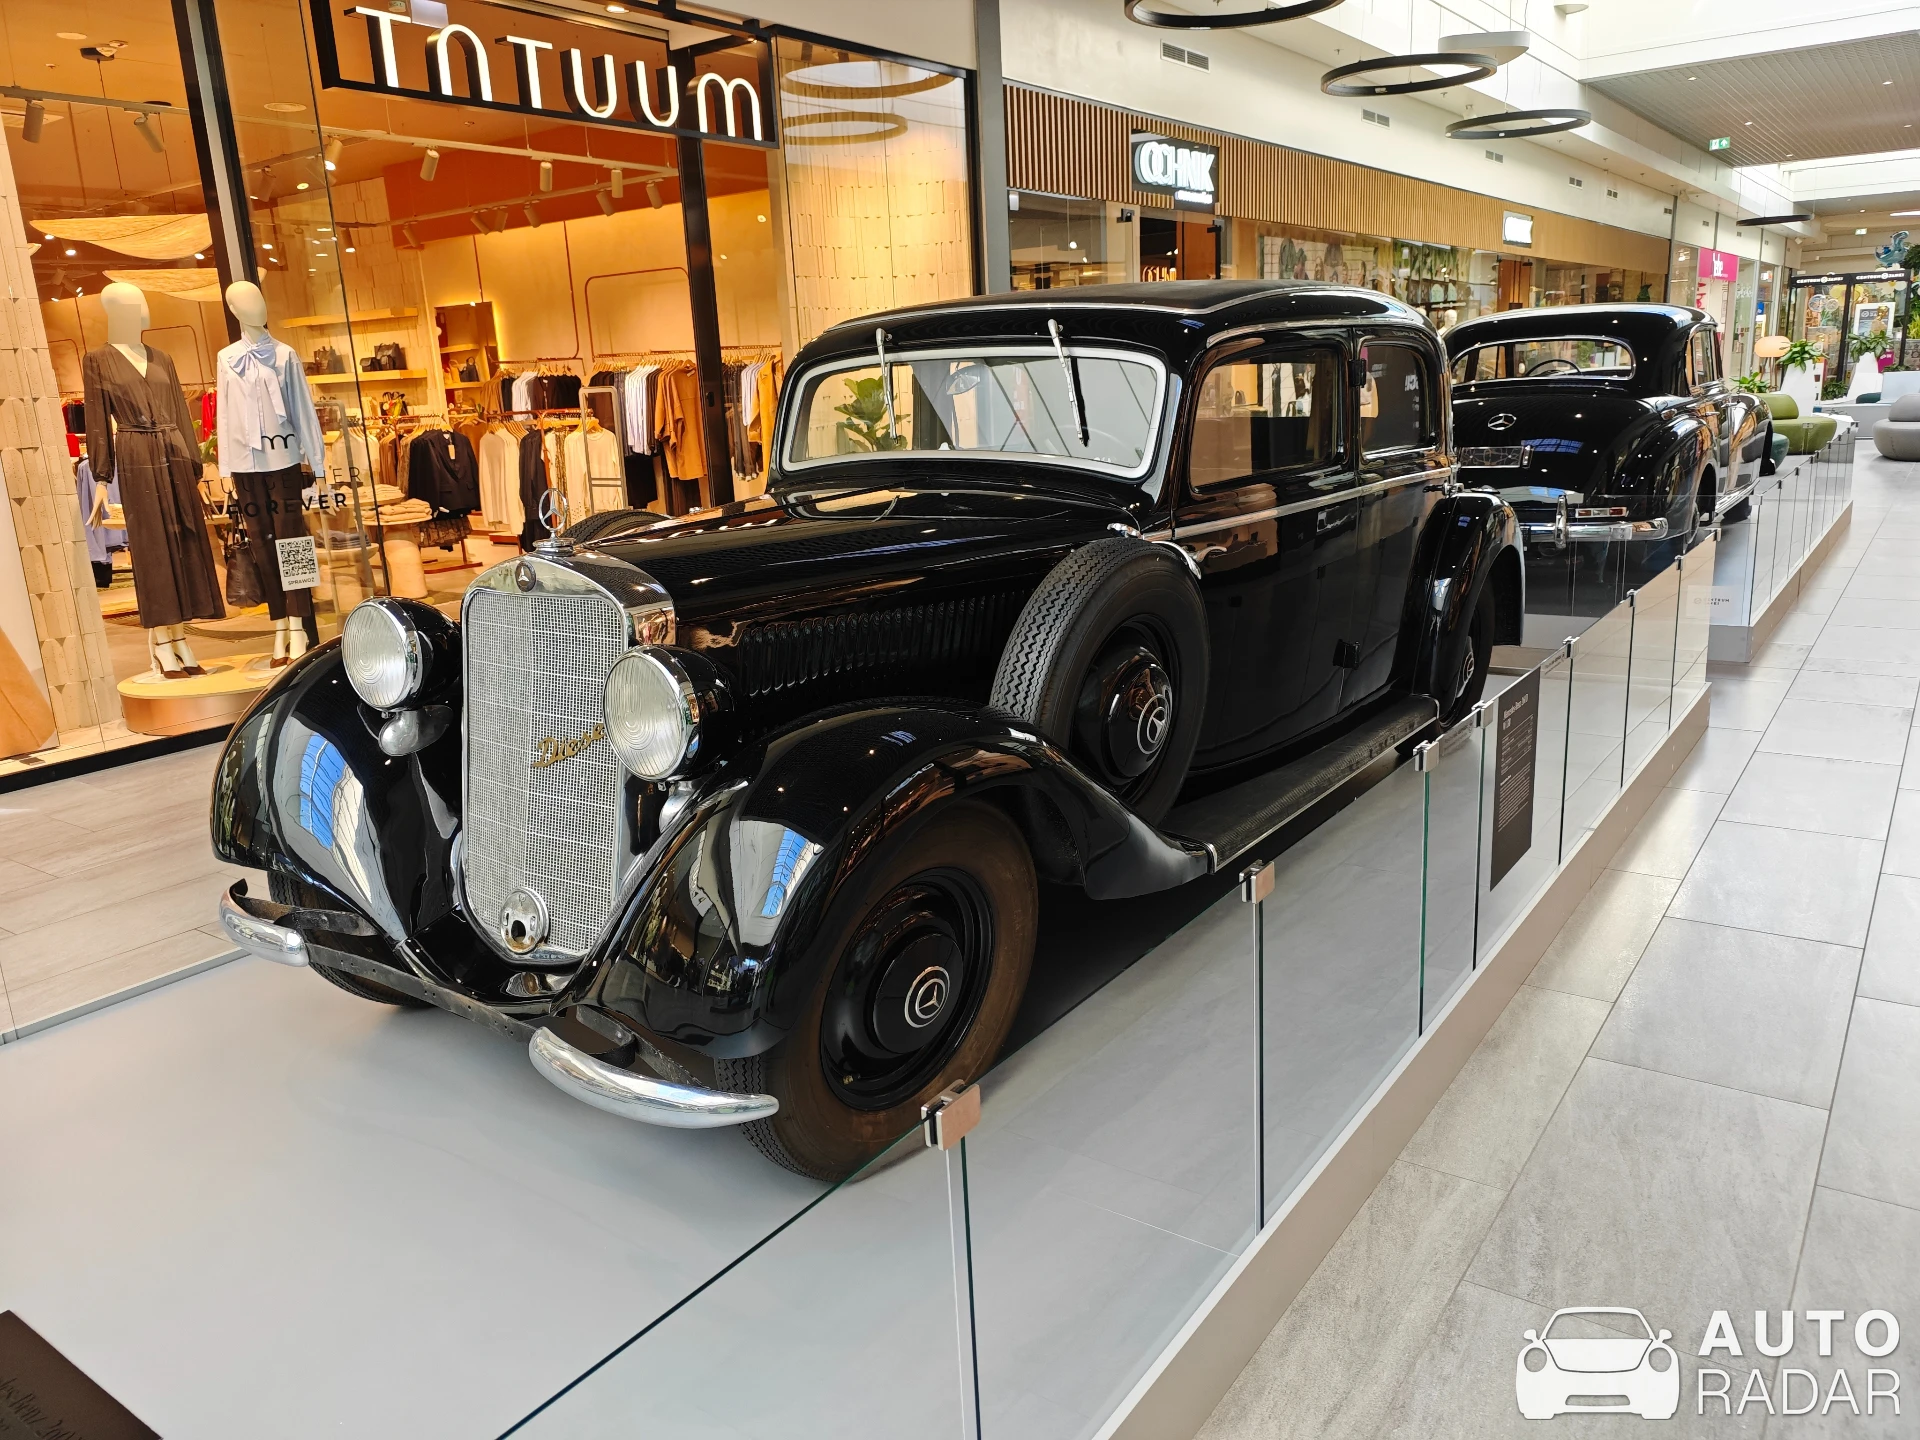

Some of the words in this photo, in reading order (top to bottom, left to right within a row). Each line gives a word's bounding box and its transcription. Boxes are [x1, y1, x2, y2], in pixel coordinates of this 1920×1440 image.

[1135, 141, 1215, 191] OCHNIK
[228, 492, 348, 519] FOREVER
[531, 722, 606, 768] Diese
